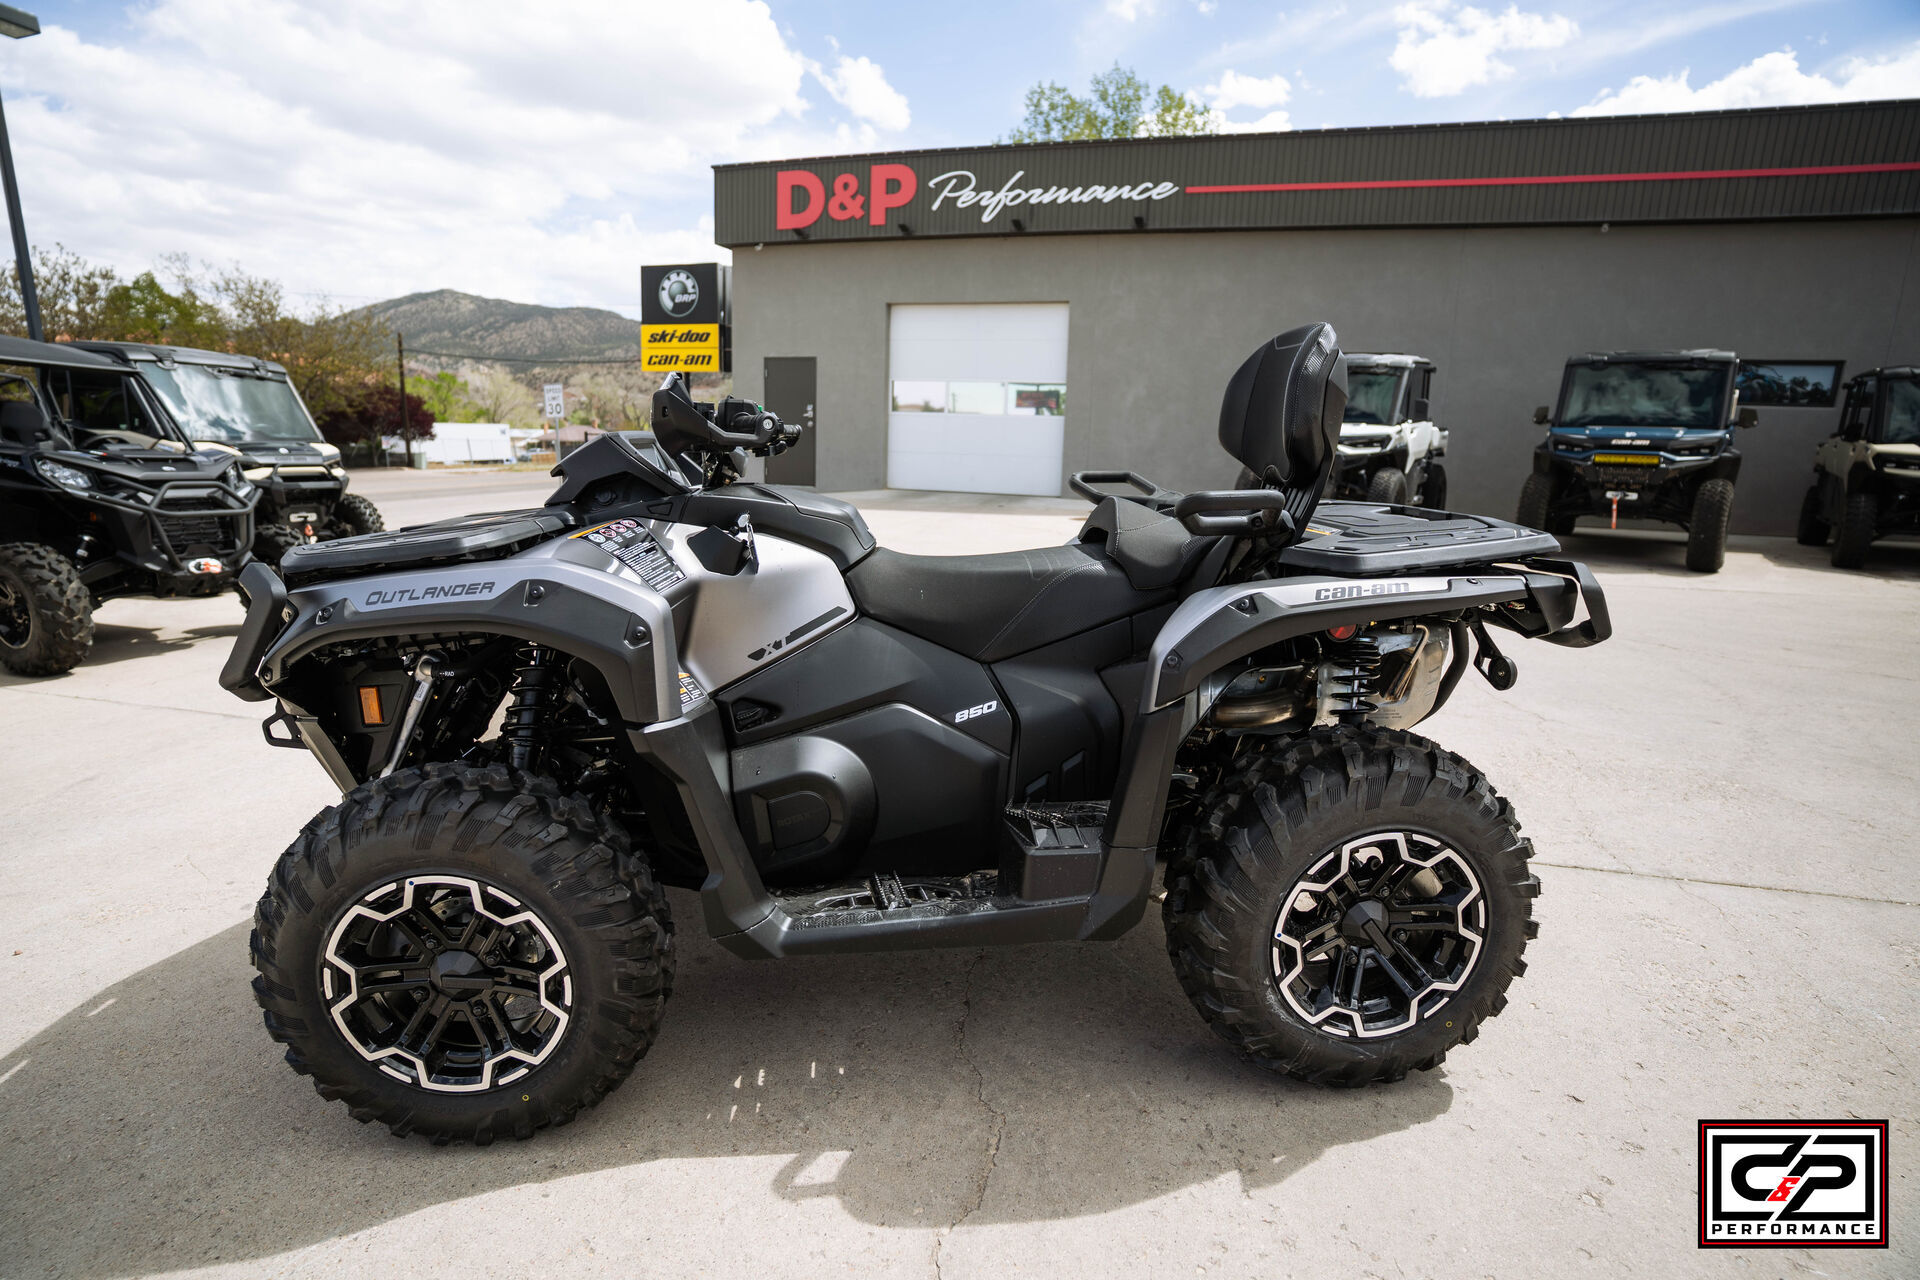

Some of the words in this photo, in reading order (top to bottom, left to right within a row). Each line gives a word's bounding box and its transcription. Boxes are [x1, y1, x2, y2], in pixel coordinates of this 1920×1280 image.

[776, 164, 917, 230] D&P
[928, 170, 1179, 222] Performance
[674, 293, 697, 304] BRP
[648, 329, 711, 344] ski-doo
[647, 354, 712, 366] can-am
[548, 403, 562, 415] 30
[365, 581, 496, 606] OUTLANDER
[1315, 582, 1409, 601] can-am
[955, 700, 997, 723] 850
